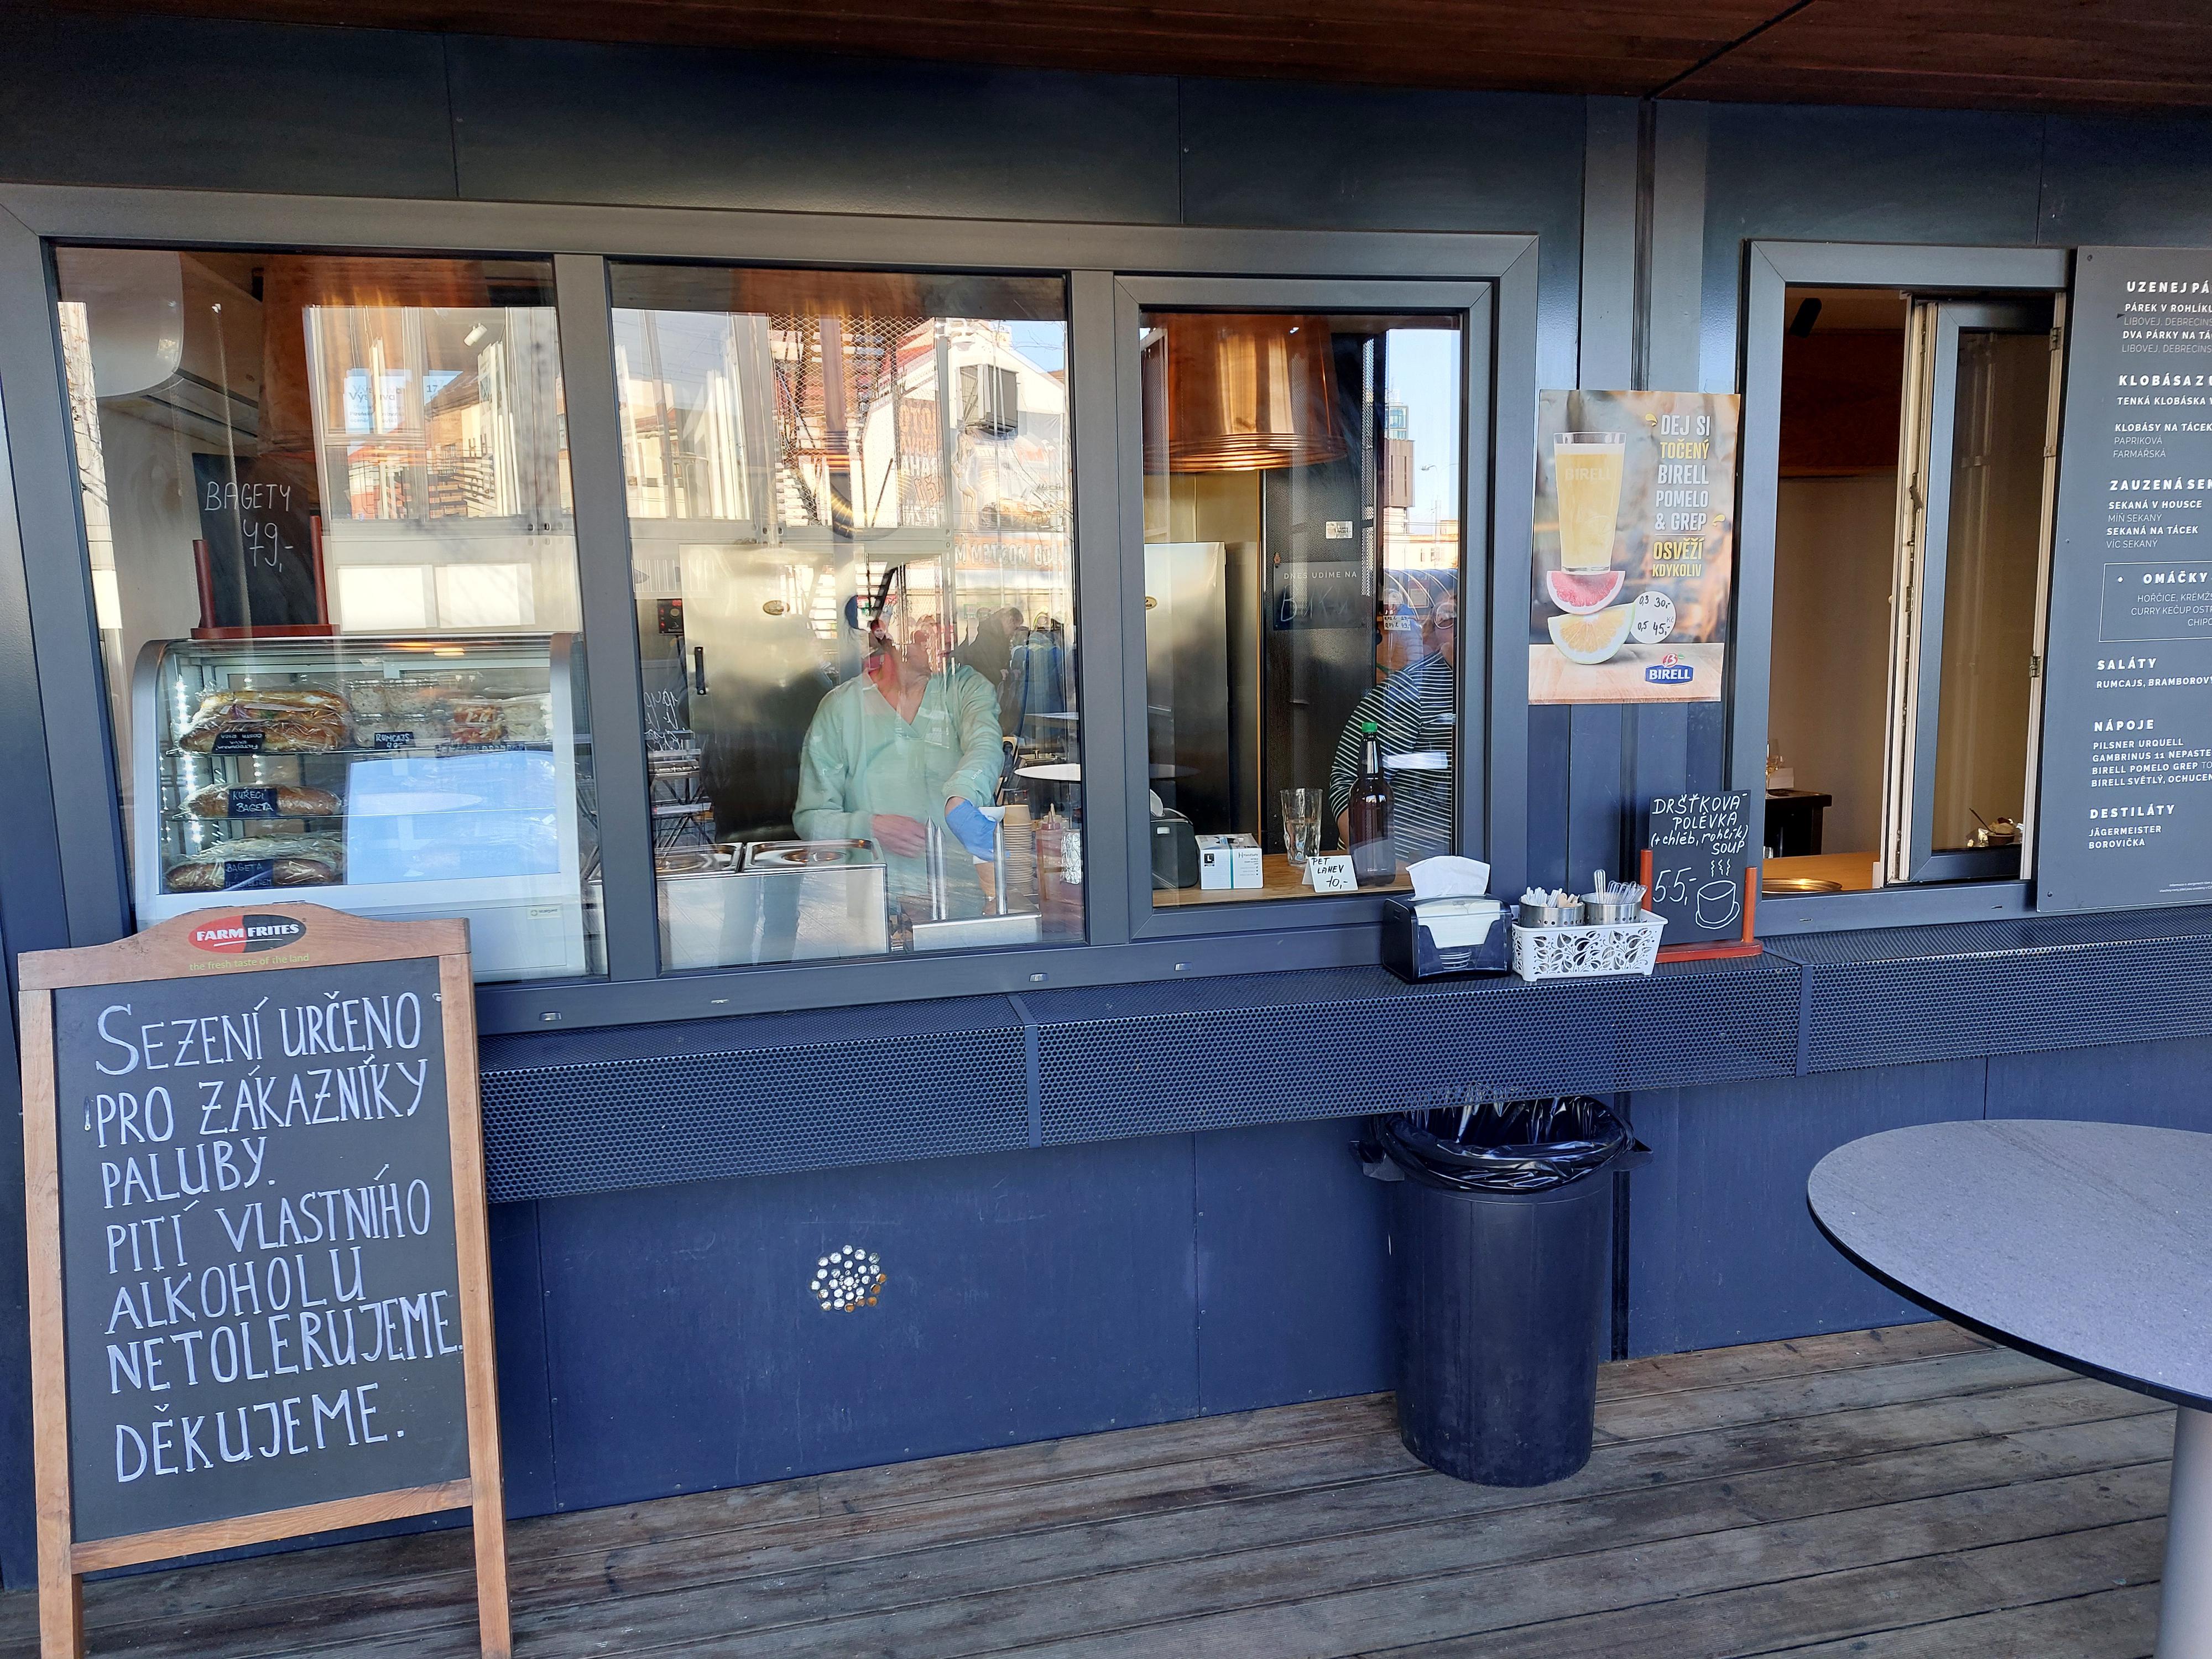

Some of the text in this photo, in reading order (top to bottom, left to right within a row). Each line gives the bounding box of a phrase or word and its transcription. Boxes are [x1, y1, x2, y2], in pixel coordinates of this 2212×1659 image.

[2127, 280, 2212, 293] UZENEJ PÁ
[2125, 302, 2157, 312] PÁREK
[2122, 331, 2142, 339] DVA
[2146, 329, 2179, 339] PÁRKY
[2199, 330, 2212, 340] TÁ
[2119, 373, 2192, 386] KLOBÁSA
[2195, 375, 2204, 386] Z
[2117, 395, 2150, 405] TENKÁ
[2154, 395, 2206, 405] KLOBÁSKA
[1661, 415, 1710, 436] DEJ SI
[2115, 422, 2161, 432] KLOBÁSY
[2181, 421, 2212, 431] TÁCEK
[2114, 435, 2163, 445] PAPRIKOVÁ
[1660, 438, 1710, 460] TOČENÝ
[2113, 448, 2166, 458] FARMÁŘSKÁ
[1565, 468, 1611, 481] BIRELL
[1658, 464, 1709, 484] BIRELL
[2110, 477, 2183, 491] ZAUZENÁ
[205, 481, 291, 512] BAGETY
[1656, 490, 1709, 508] POMELO
[2109, 499, 2203, 509] SEKANÁ V HOUSCE
[1655, 513, 1707, 531] & GREP
[2127, 512, 2162, 522] SEKANÝ
[2106, 524, 2199, 535] SEKANÁ NA TÁCEK
[243, 519, 294, 573] 49,-
[1653, 537, 1705, 560] OSVĚŽÍ
[2106, 538, 2158, 548] VÍC SEKANÝ
[1312, 570, 1340, 578] UDÍME
[1652, 564, 1702, 577] KDYKOLIV
[2143, 570, 2208, 584] OMÁČKY
[1639, 595, 1671, 609] 0,3 30,-
[2131, 607, 2160, 615] CURRY
[2162, 605, 2191, 614] KEČUP
[1637, 621, 1671, 635] 0,5 45,-
[2097, 656, 2157, 670] SALÁTY
[1649, 669, 1691, 680] BIRELL
[2096, 679, 2146, 688] RUMCAJS,
[2094, 718, 2154, 732] NÁPOJE
[375, 733, 410, 742] RUMCAJS
[2093, 738, 2184, 750] PILSNER URQUELL
[2093, 752, 2151, 762] GAMBRINUS
[2168, 749, 2212, 759] NEPASTE
[2091, 765, 2126, 775] BIRELL
[2130, 763, 2169, 773] POMELO
[2173, 761, 2198, 771] GREP
[2091, 777, 2126, 787] BIRELL
[236, 802, 274, 812] BAGETA
[2090, 804, 2176, 819] DESTILÁTY
[1672, 812, 1738, 831] POLÉVKA
[1701, 824, 1749, 844] rohlík)
[2088, 825, 2162, 837] JÄGERMEISTER
[1711, 841, 1745, 855] SOUP
[2088, 838, 2145, 849] BOROVIČKA
[1311, 857, 1331, 865] PET
[225, 863, 262, 873] BAGETA
[1317, 864, 1344, 874] LAHEV
[1652, 867, 1697, 906] 55,-
[196, 924, 299, 941] FARM FRITES
[208, 959, 231, 969] fresh
[234, 958, 257, 967] taste
[259, 956, 270, 965] of
[272, 956, 287, 964] the
[290, 954, 310, 963] land
[96, 991, 421, 1076] SEZENÍ URČENO
[96, 1053, 428, 1149] PRO ZÁKAZNÍKY
[101, 1136, 275, 1208] PALUBY.
[106, 1163, 431, 1274] PITÍ VLASTNÍHO
[104, 1246, 366, 1334] ALKOHOLU
[116, 1383, 404, 1483] DĚKUJEME.
